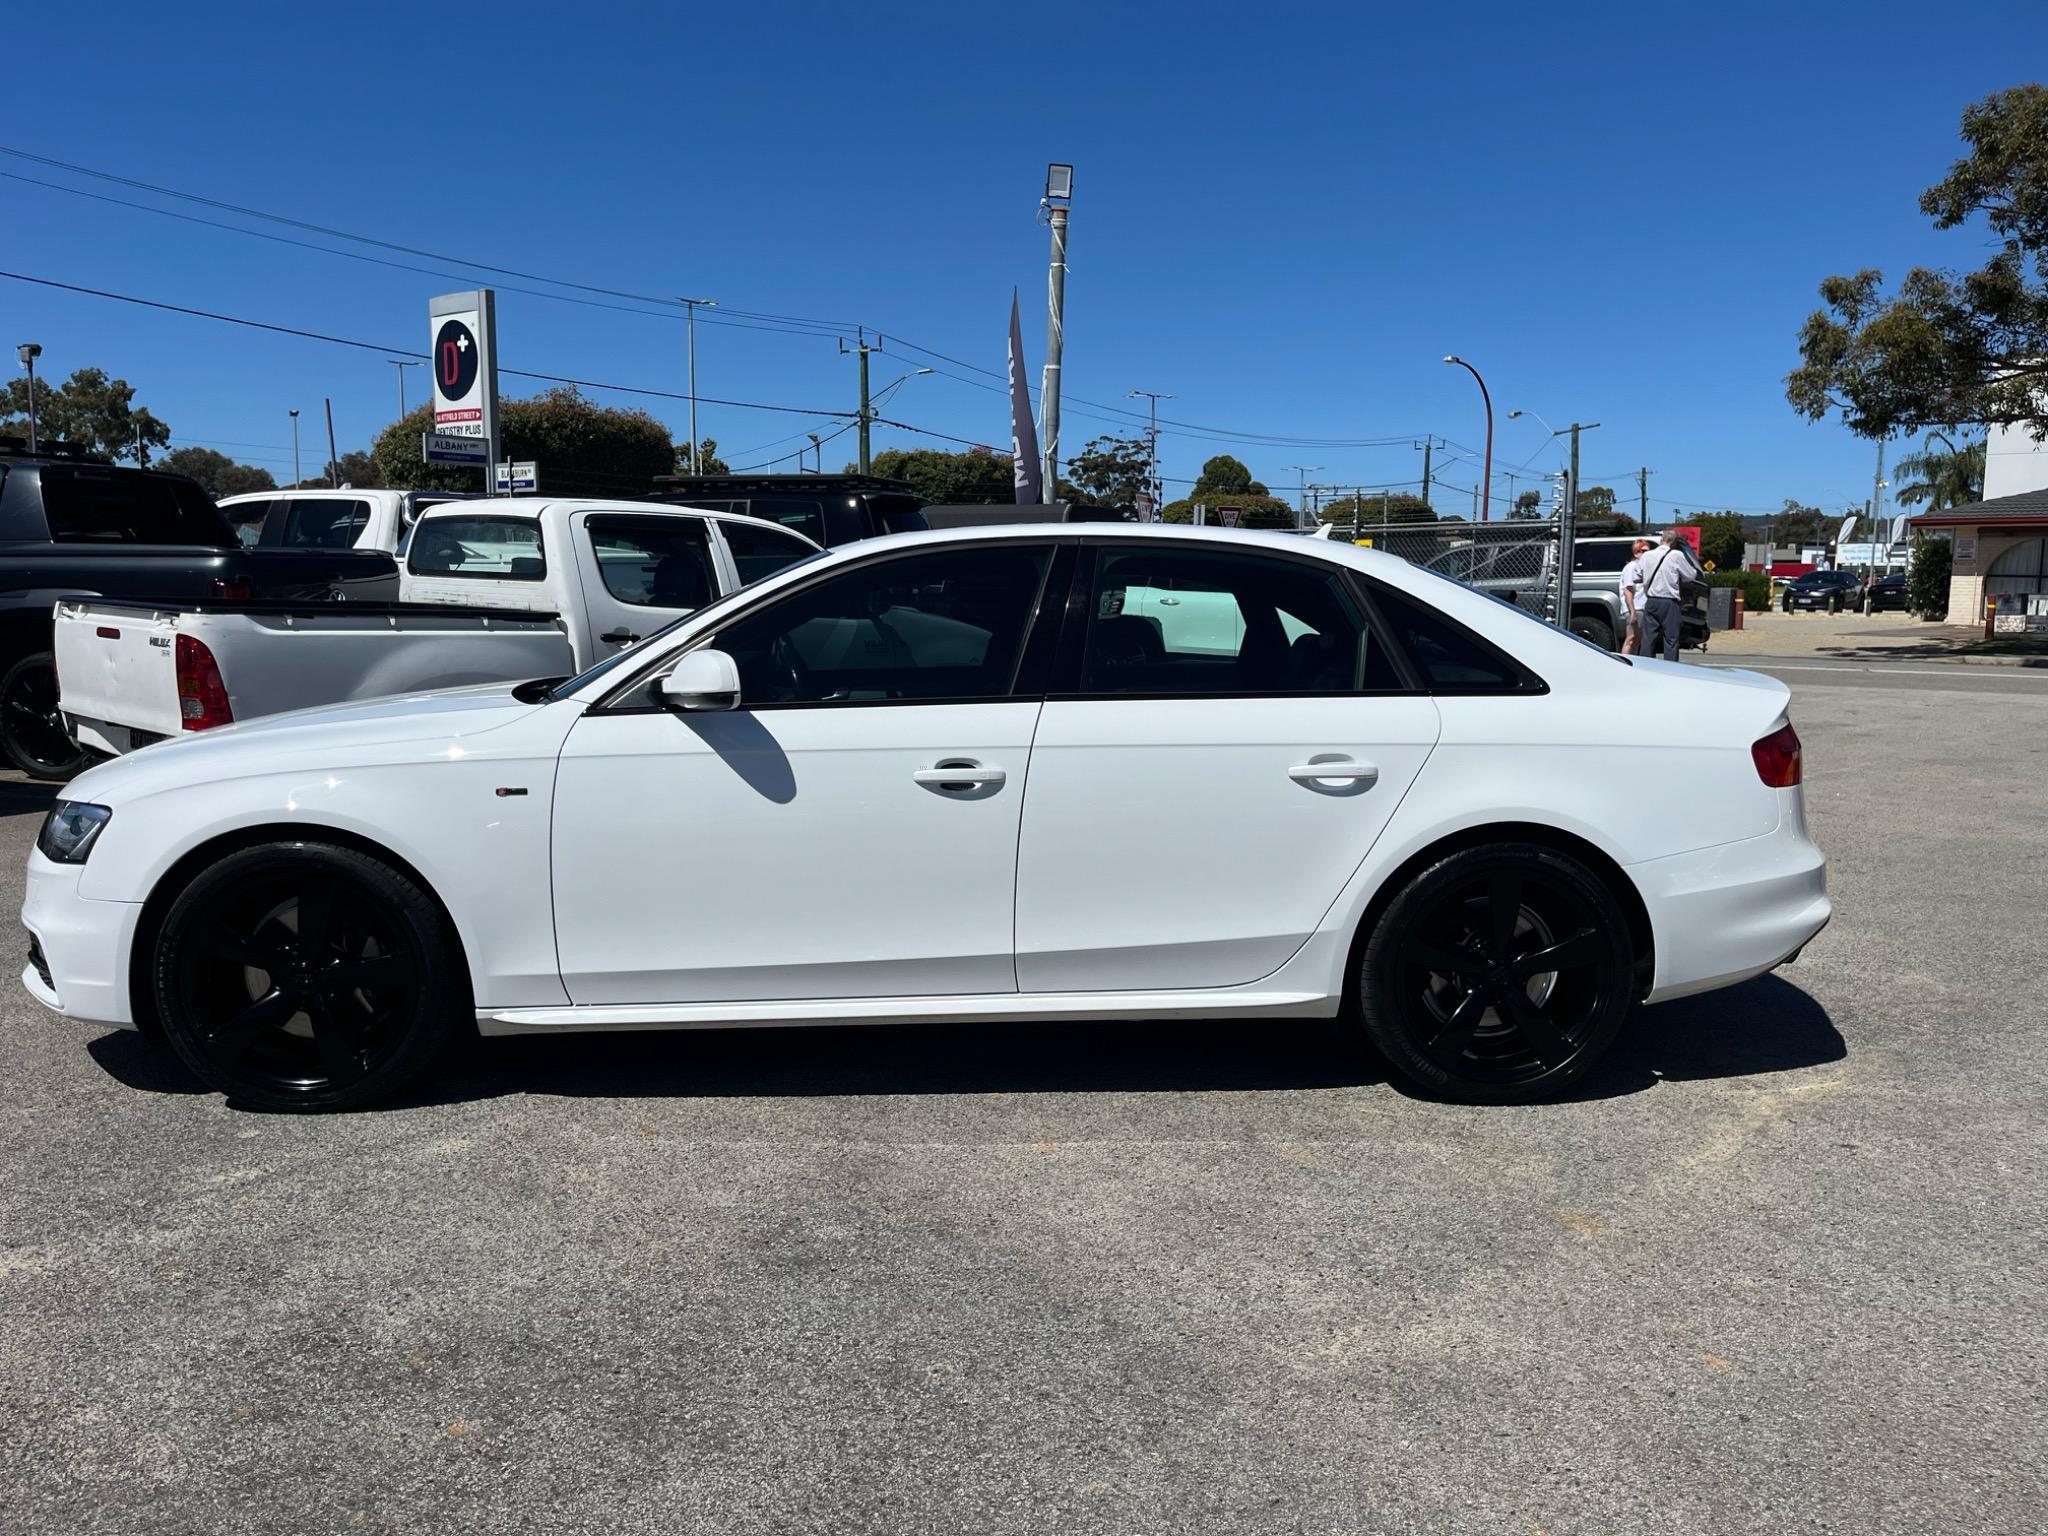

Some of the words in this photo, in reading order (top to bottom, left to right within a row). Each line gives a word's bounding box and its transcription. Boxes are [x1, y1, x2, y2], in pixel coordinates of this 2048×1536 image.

[458, 411, 475, 419] STREET
[465, 424, 482, 435] PLUS
[434, 440, 469, 451] ALBANY
